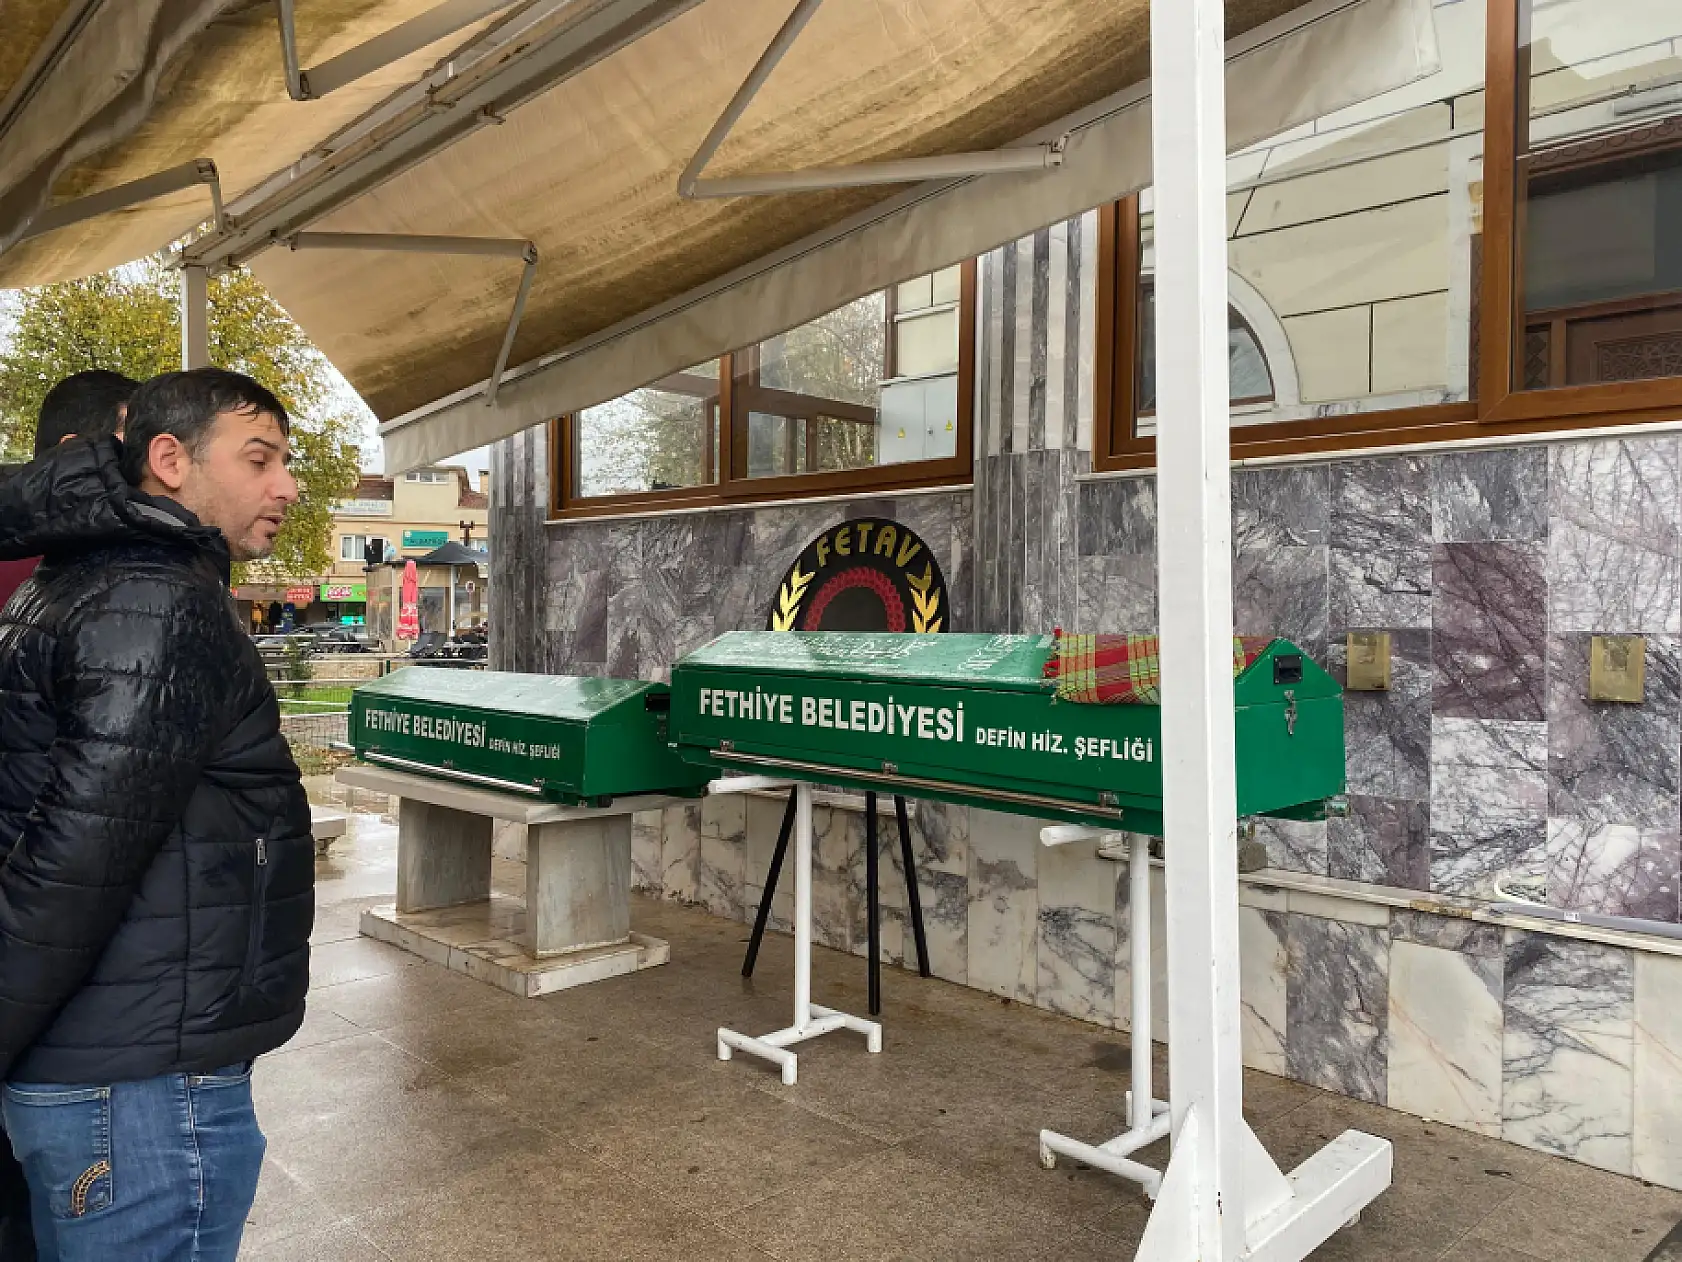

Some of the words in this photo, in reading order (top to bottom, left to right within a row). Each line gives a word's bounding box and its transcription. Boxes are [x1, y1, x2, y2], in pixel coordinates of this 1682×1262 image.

[816, 522, 922, 567] FETAV
[365, 706, 411, 735] FETHİYE
[413, 715, 487, 748] BELEDİYESİ
[700, 685, 794, 724] FETHİYE
[801, 695, 964, 742] BELEDİYESİ
[975, 726, 1026, 750] DEFİN
[1031, 729, 1068, 754] HİZ.
[1074, 736, 1154, 762] ŞEFLİĞİ
